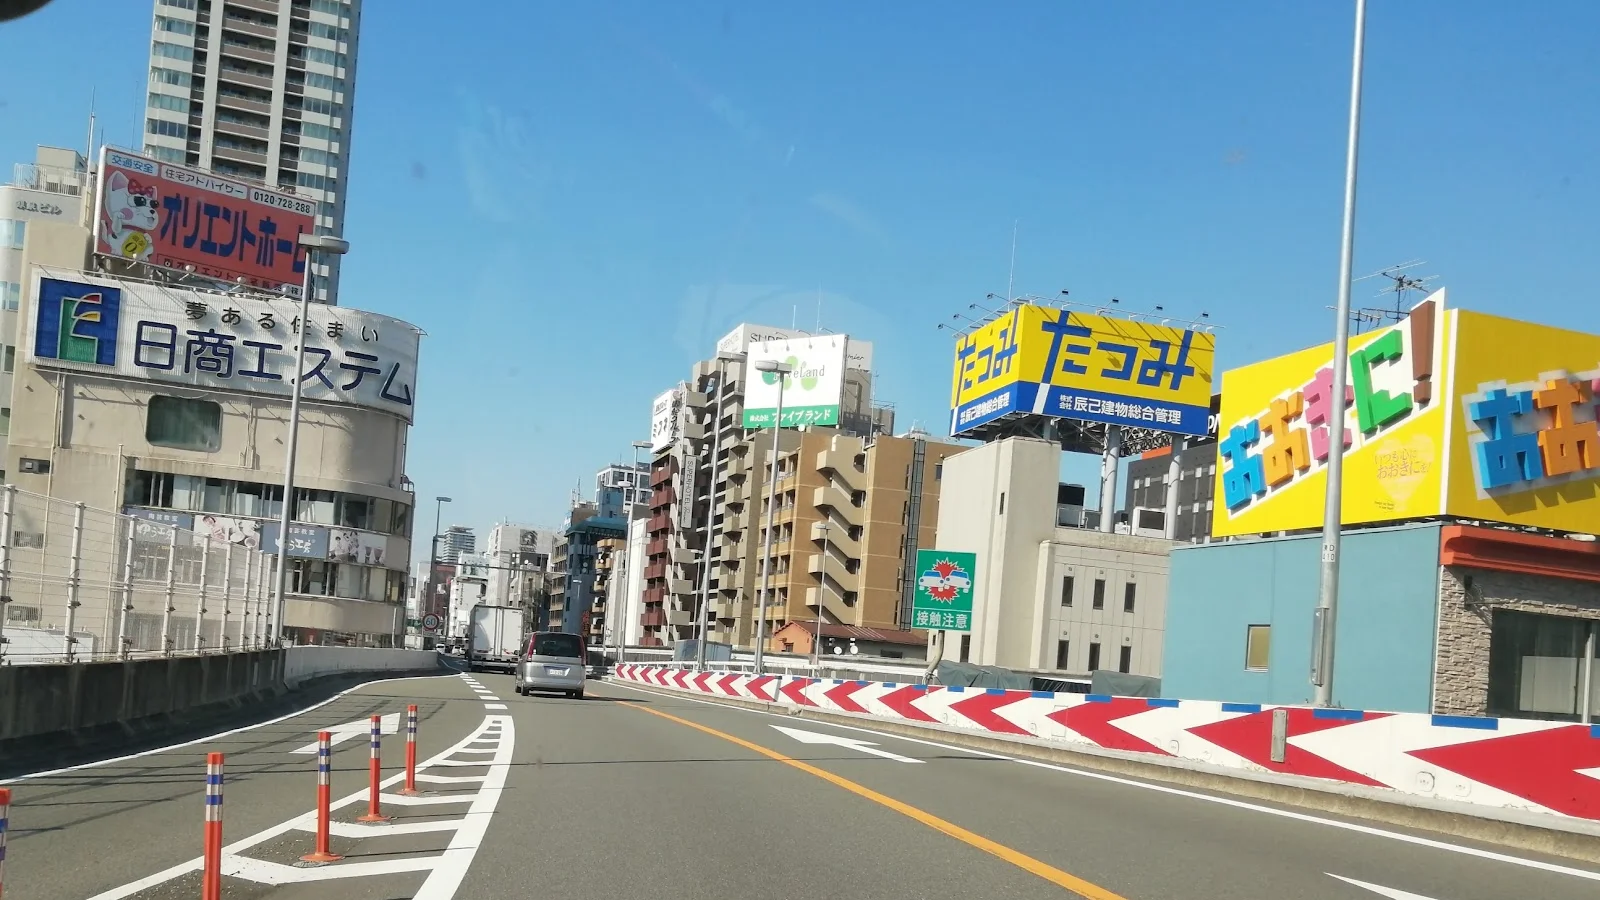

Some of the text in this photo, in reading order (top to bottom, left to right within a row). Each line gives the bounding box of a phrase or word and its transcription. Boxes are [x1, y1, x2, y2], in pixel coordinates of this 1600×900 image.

[111, 154, 154, 174] 交通安全
[134, 320, 412, 406] 日商エステム
[1041, 309, 1195, 391] たつみ
[1470, 378, 1600, 489] おお
[425, 617, 436, 626] 60
[916, 610, 968, 629] 接触注意
